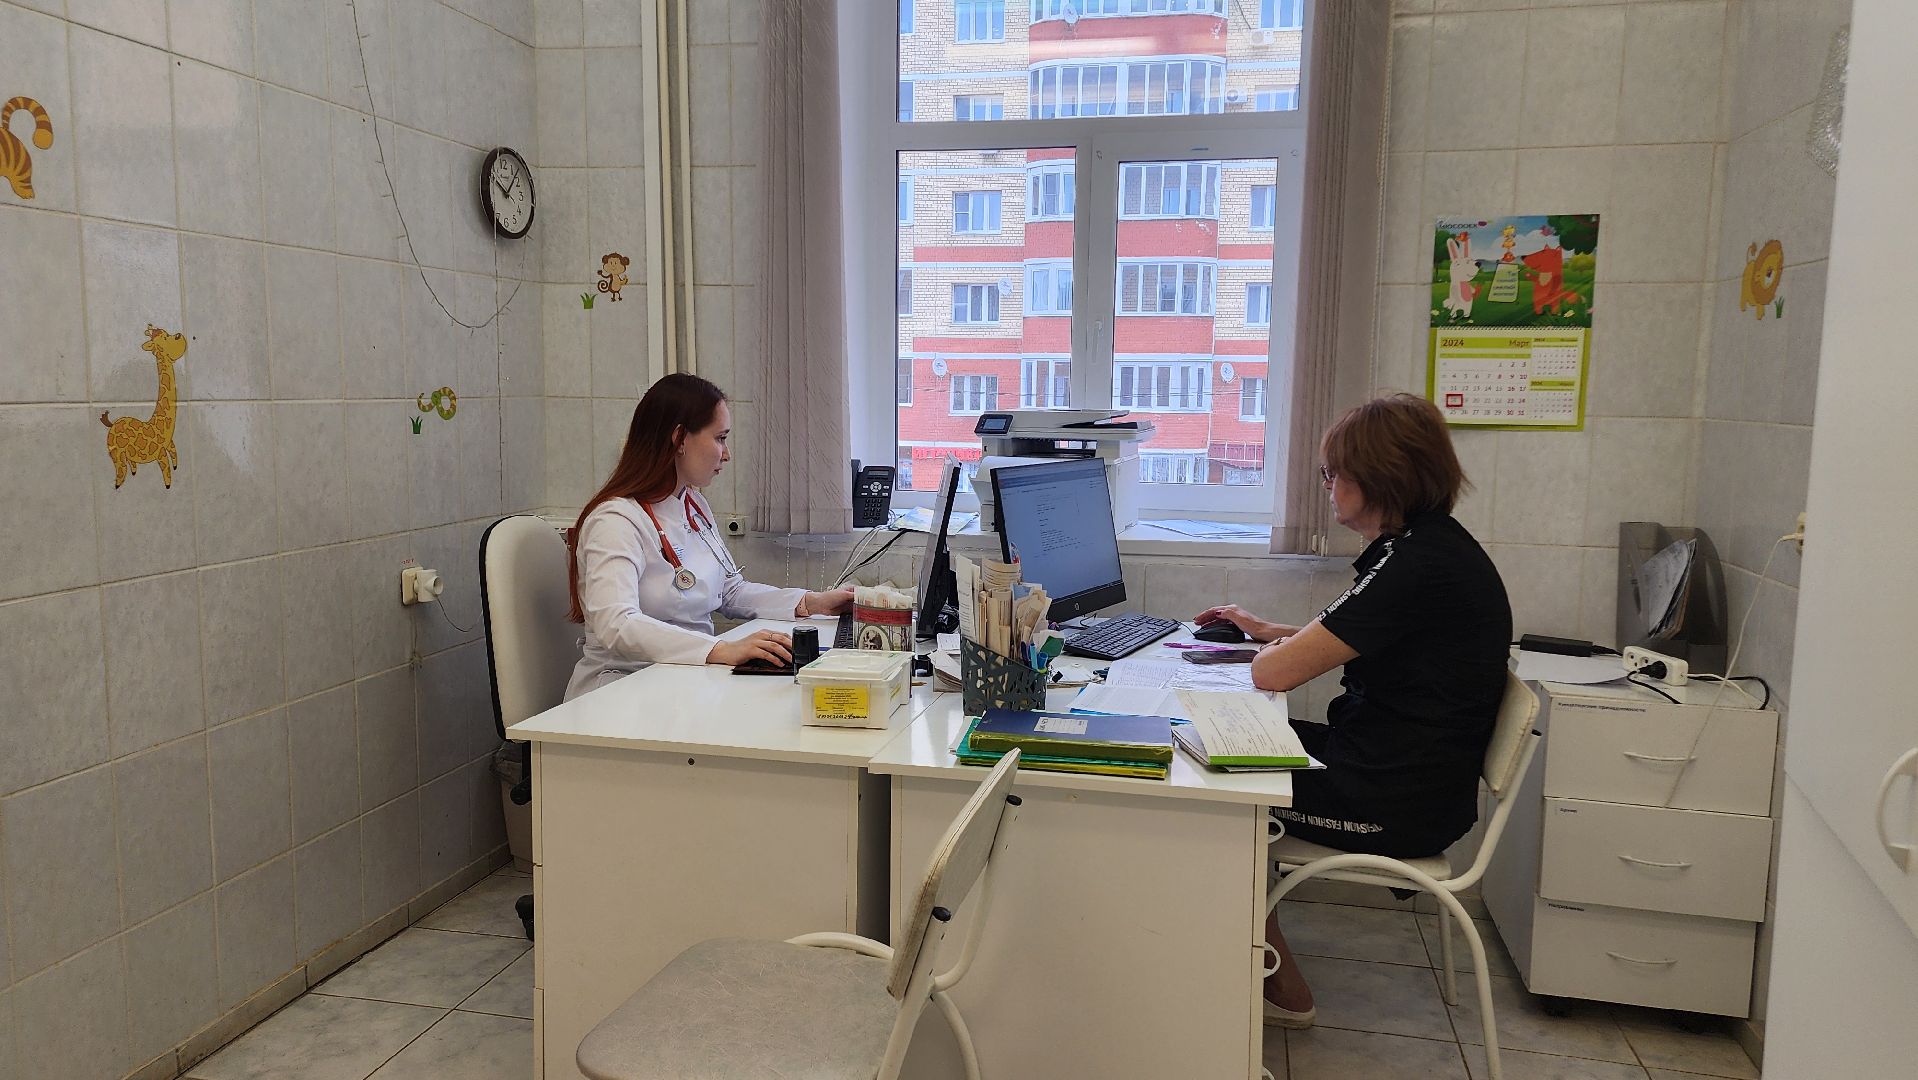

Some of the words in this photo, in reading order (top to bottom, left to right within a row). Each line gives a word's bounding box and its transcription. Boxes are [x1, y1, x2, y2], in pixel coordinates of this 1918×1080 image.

[499, 158, 508, 170] 12
[515, 176, 520, 187] 2
[518, 191, 524, 201] 3
[516, 205, 521, 215] 4
[503, 217, 510, 228] 6
[512, 214, 517, 224] 5
[1442, 339, 1465, 347] 2024
[1351, 570, 1377, 596] FASHIO
[1326, 589, 1352, 614] ASHION
[1274, 807, 1306, 823] FASHION
[1307, 815, 1342, 830] FASHION
